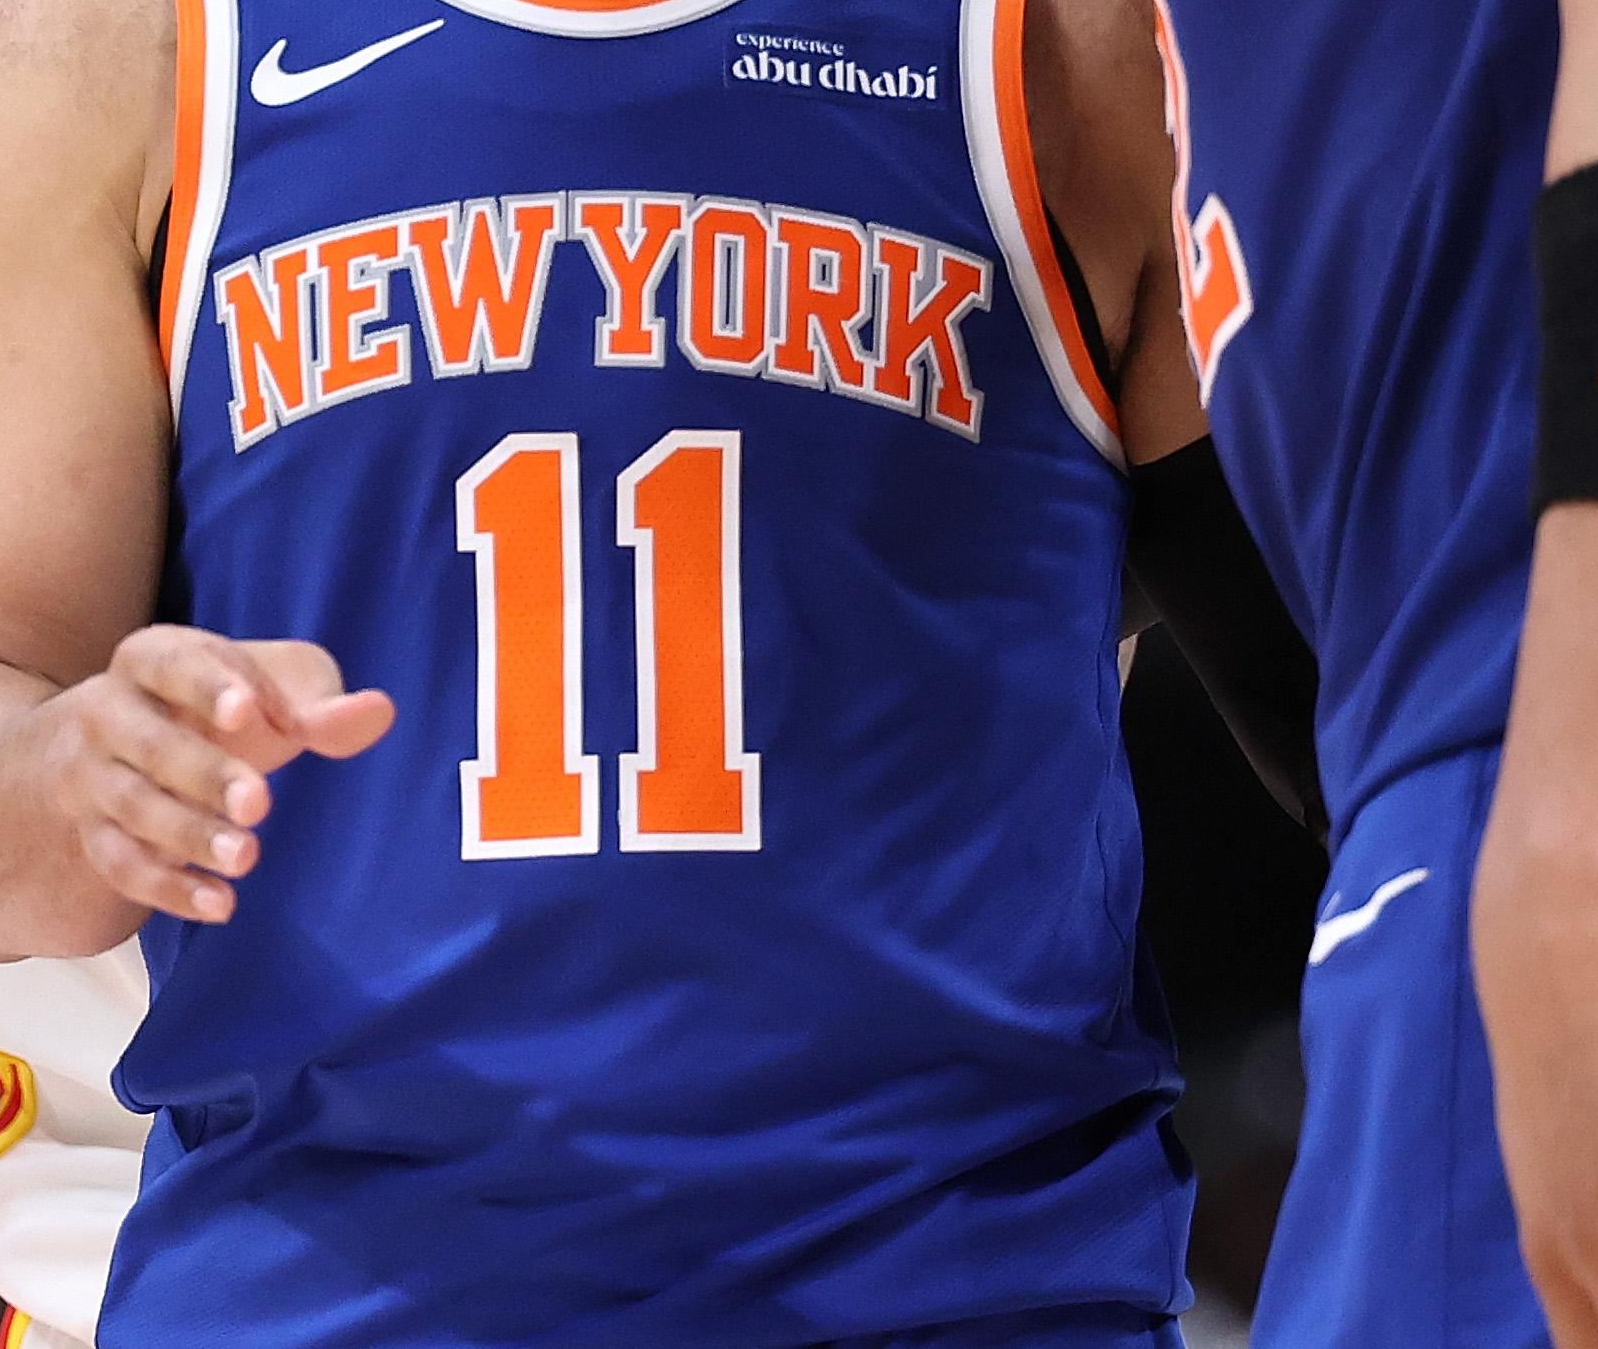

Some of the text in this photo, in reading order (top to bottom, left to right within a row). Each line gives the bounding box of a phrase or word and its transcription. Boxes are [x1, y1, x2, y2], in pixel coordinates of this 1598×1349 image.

[732, 50, 811, 87] abu
[735, 32, 845, 56] experience
[213, 190, 994, 454] NEW YORK
[455, 429, 762, 861] 11
